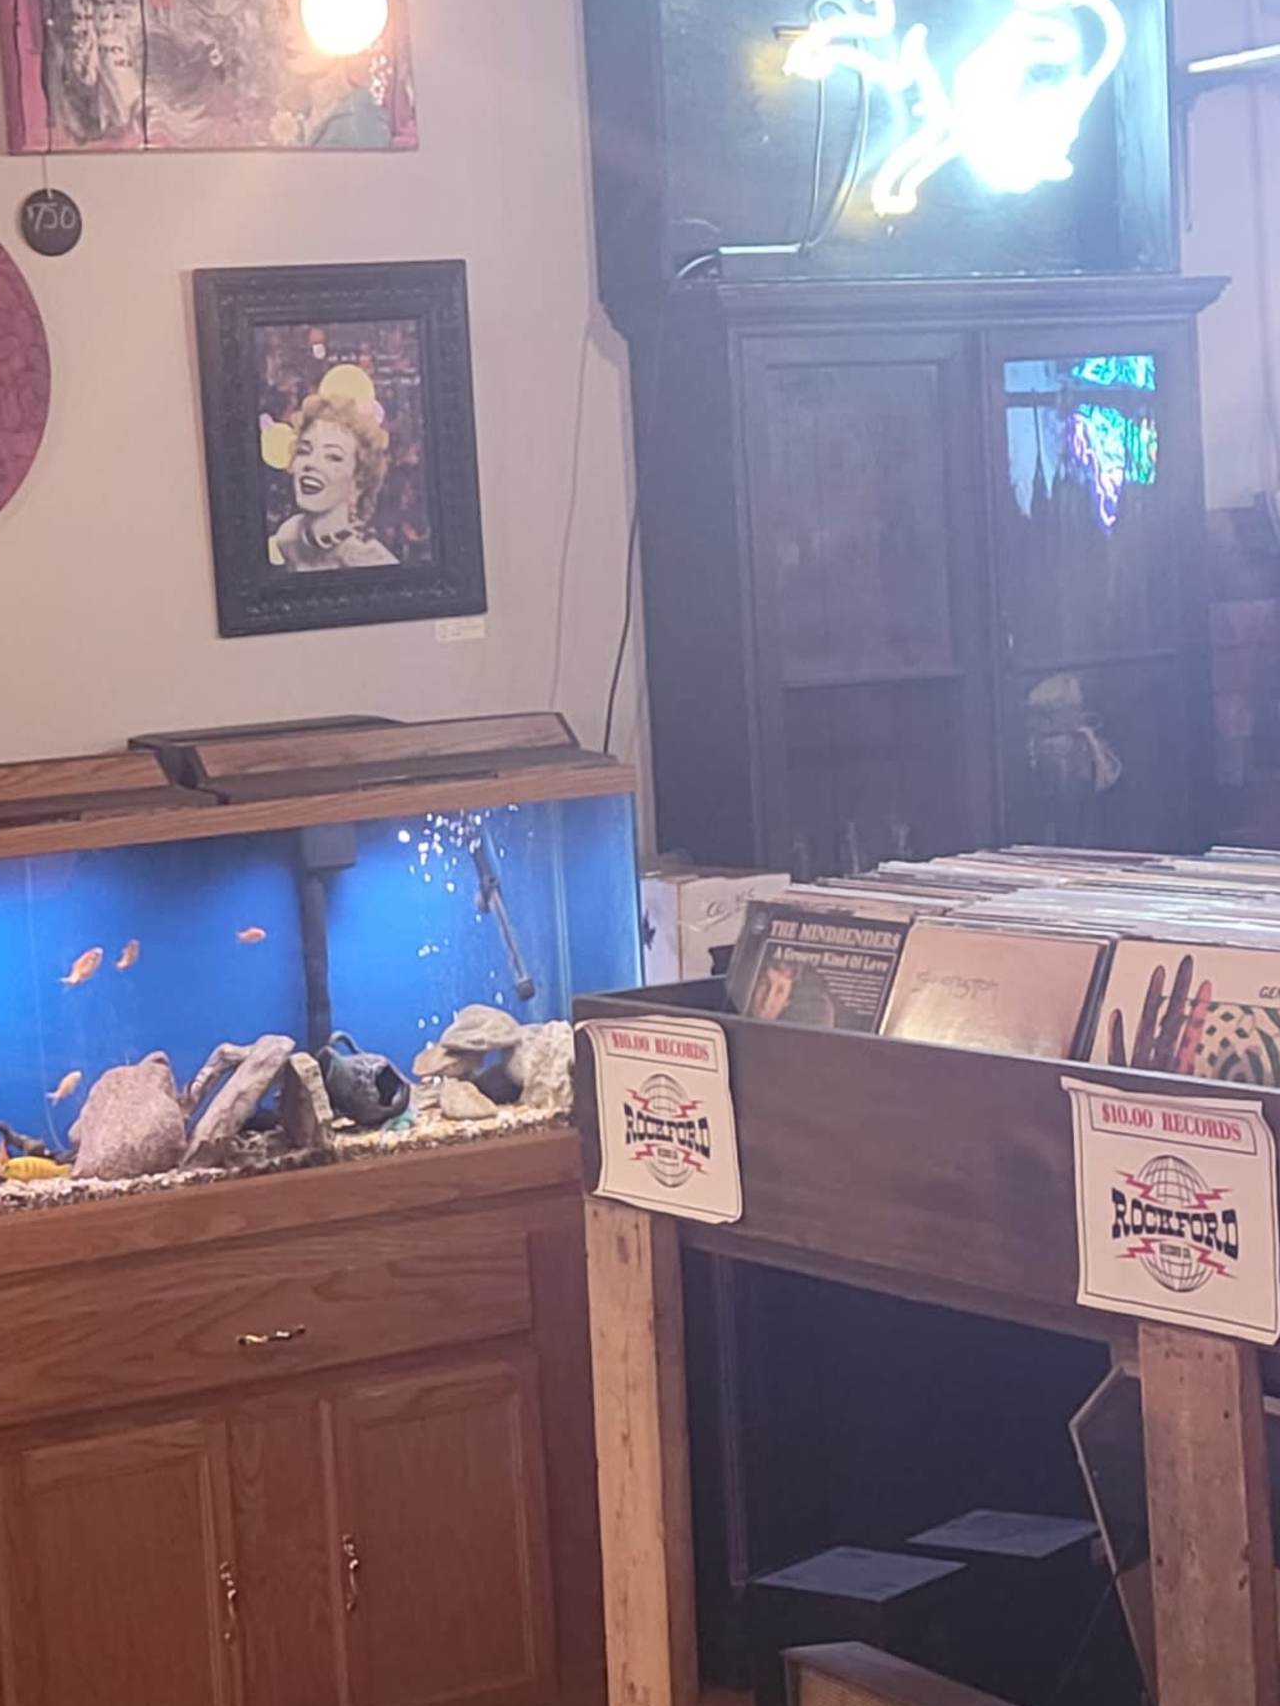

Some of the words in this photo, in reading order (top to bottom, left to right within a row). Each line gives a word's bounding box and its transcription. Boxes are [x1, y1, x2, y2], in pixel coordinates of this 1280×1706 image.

[771, 919, 799, 940] THE
[798, 923, 901, 950] MINDBENDERS
[773, 946, 782, 960] A
[823, 952, 849, 968] Kind
[863, 957, 889, 972] Love
[655, 1038, 710, 1061] RECORDS
[623, 1102, 711, 1160] ROCKFORD
[1102, 1102, 1153, 1128] $10.00
[1162, 1111, 1242, 1142] RECORDS
[1111, 1187, 1239, 1260] ROCKFORD
